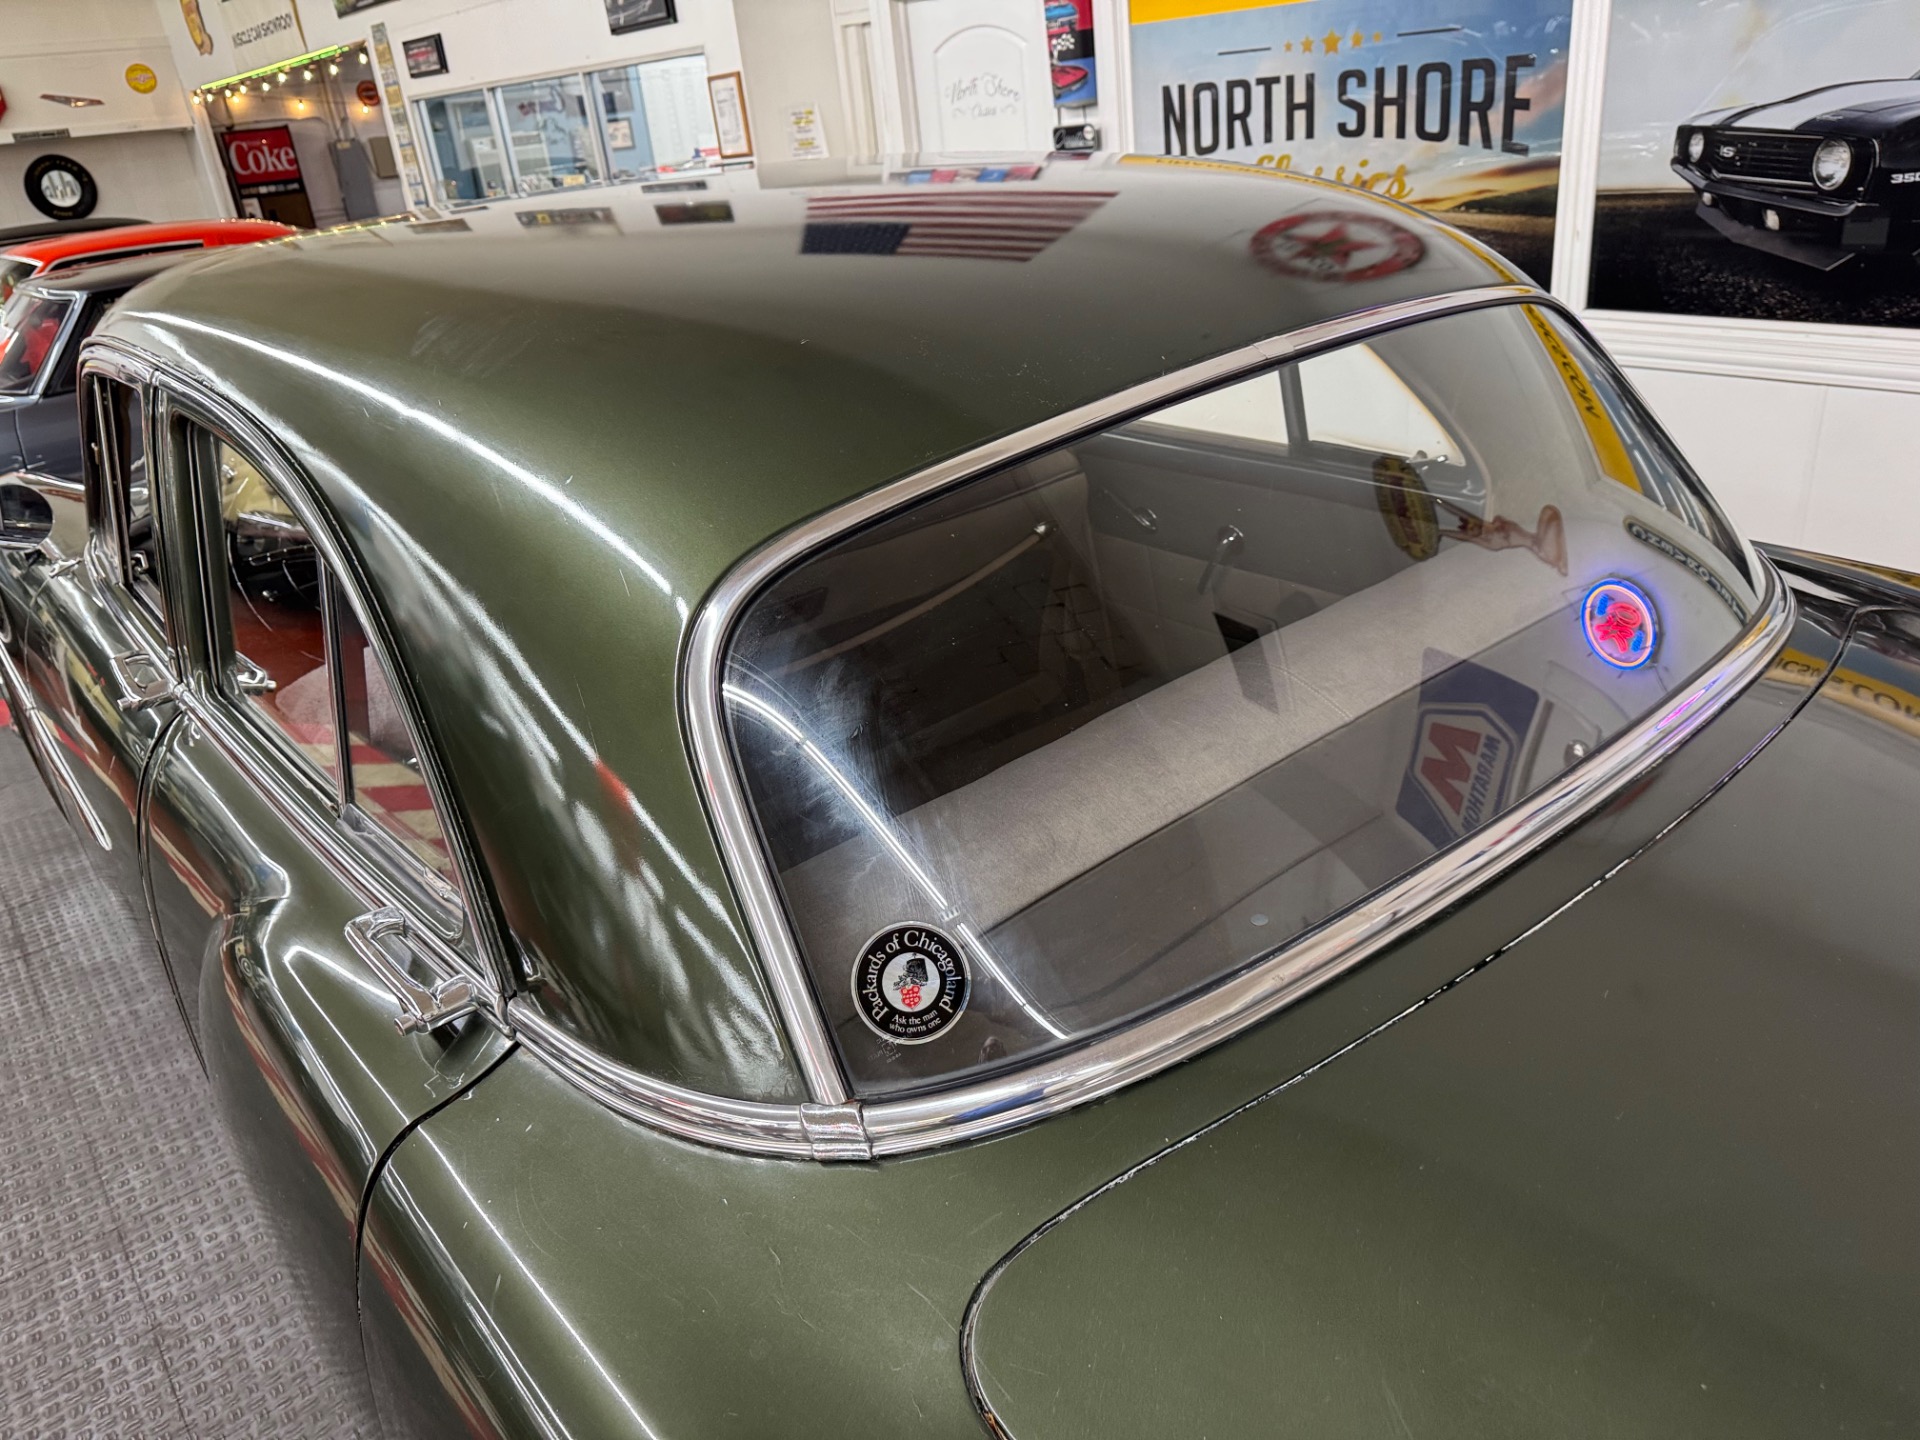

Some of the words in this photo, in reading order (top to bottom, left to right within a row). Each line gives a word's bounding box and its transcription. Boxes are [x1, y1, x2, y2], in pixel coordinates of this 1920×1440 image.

[1162, 73, 1315, 157] NORTH
[1336, 53, 1536, 157] SHORE
[229, 140, 297, 176] Coke
[863, 950, 889, 1021] Packards
[885, 933, 900, 953] of
[903, 930, 962, 1013] Chicagoland
[889, 1023, 905, 1033] who
[906, 1025, 927, 1033] owns
[927, 1017, 941, 1029] one
[892, 1014, 907, 1025] Ask
[908, 1016, 921, 1025] the
[922, 1010, 938, 1021] man
